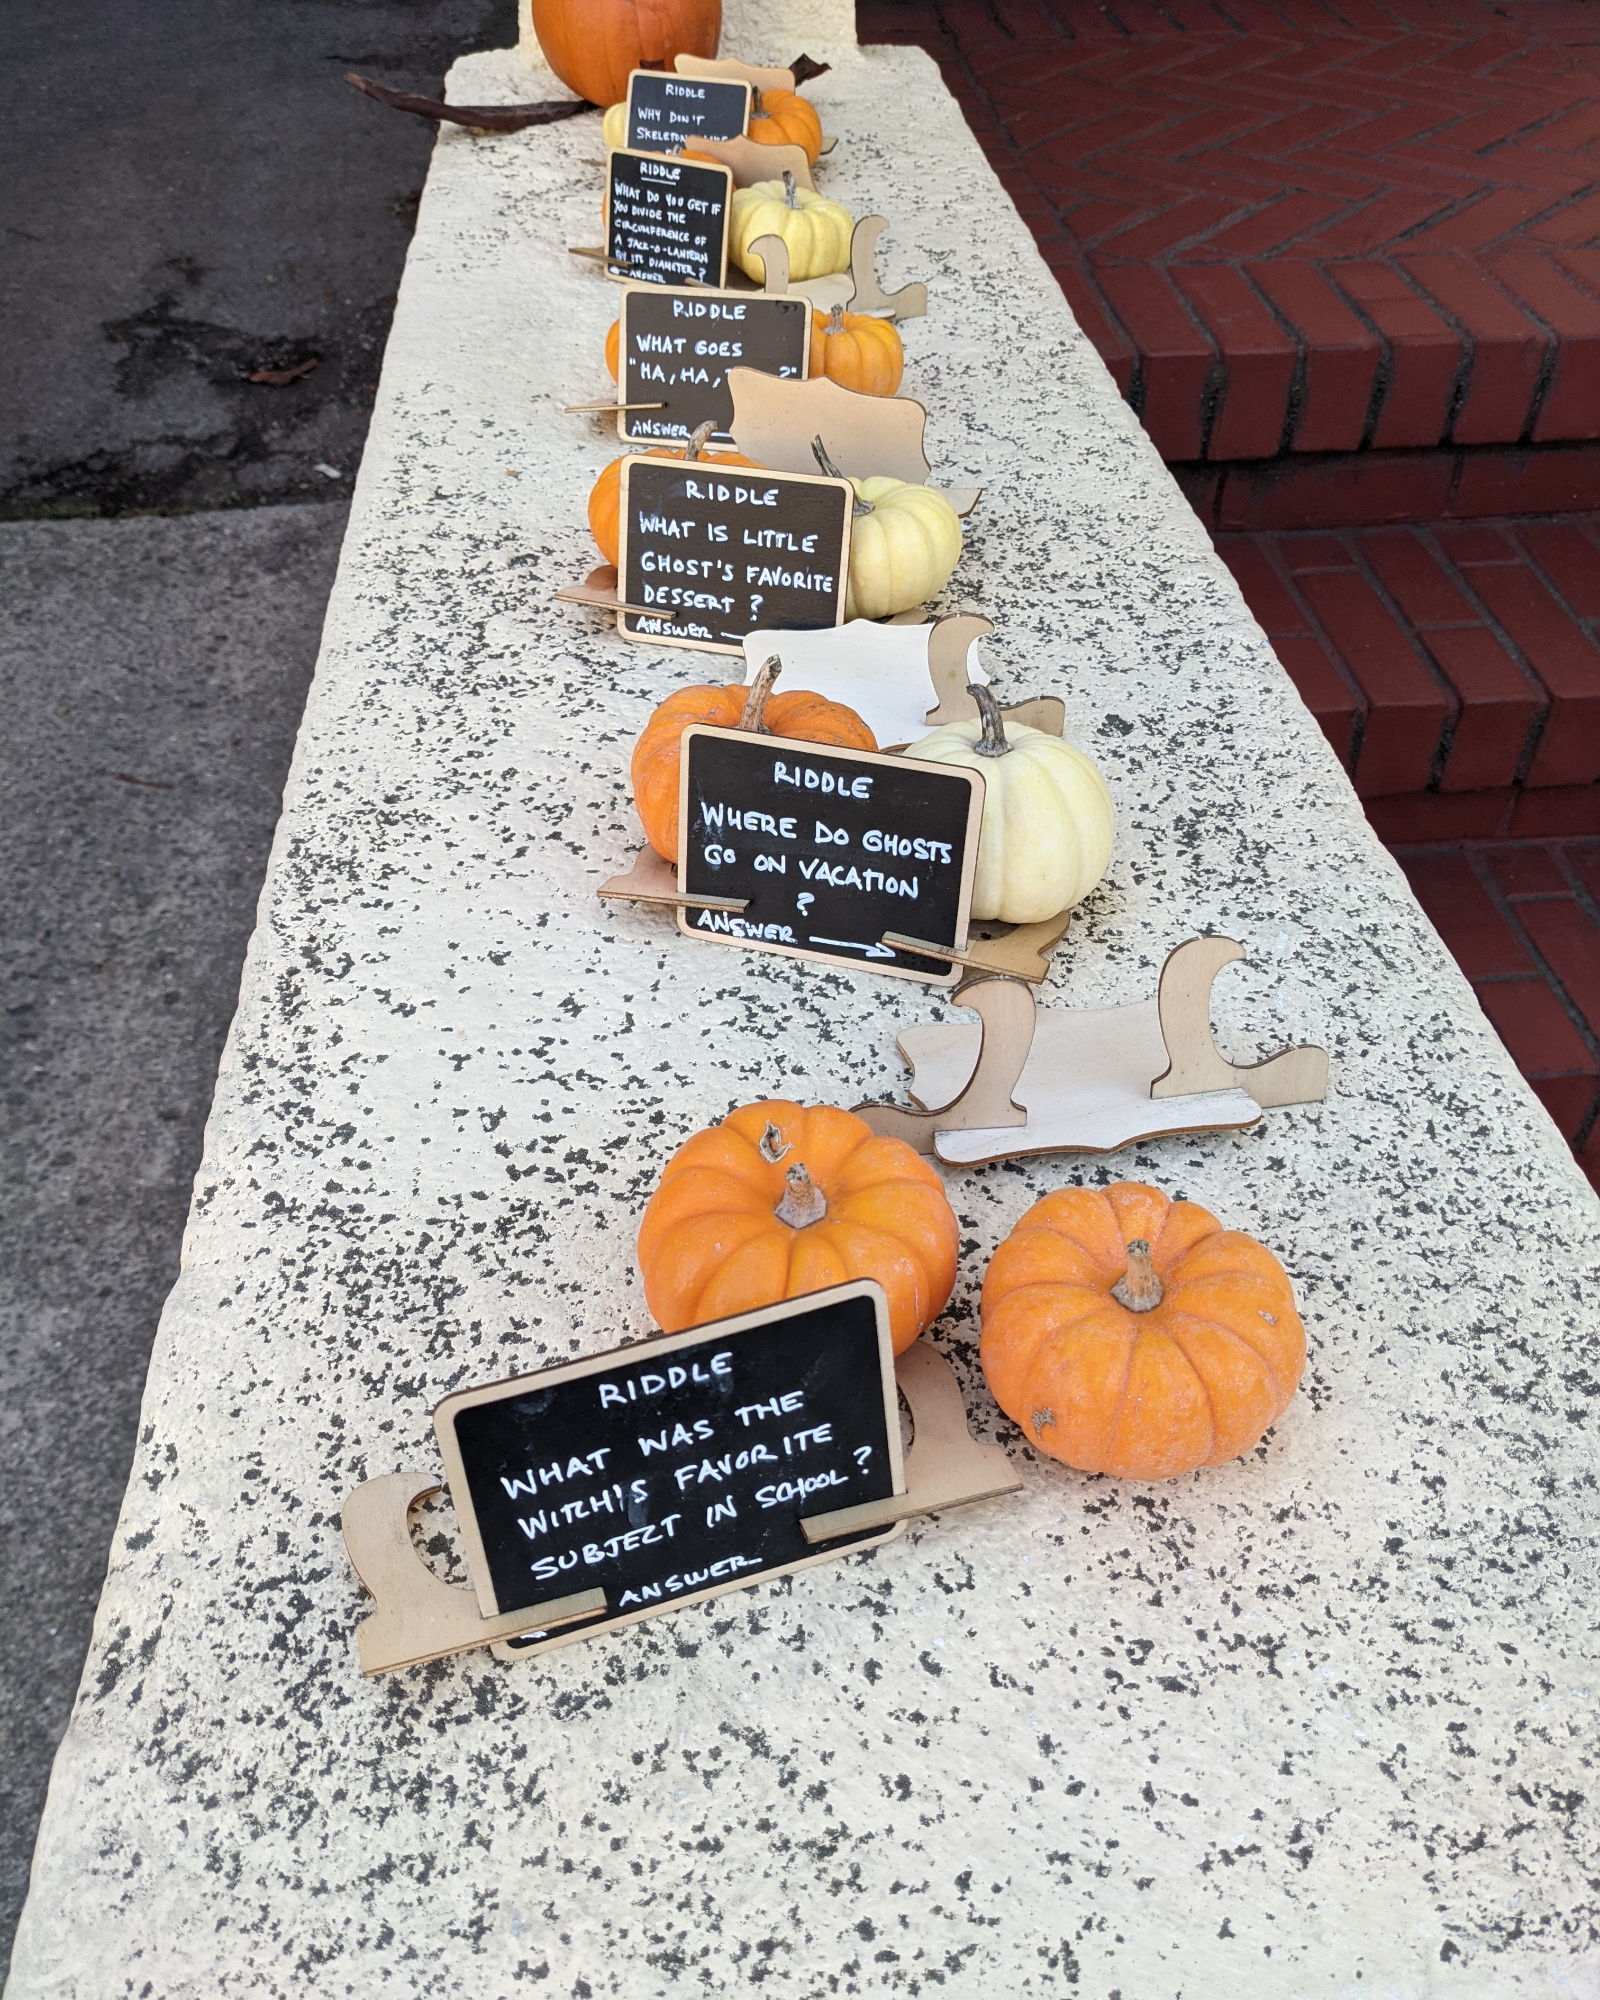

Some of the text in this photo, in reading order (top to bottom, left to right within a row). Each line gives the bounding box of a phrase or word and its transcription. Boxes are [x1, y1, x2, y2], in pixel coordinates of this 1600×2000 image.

[665, 83, 706, 99] RIDDLE
[637, 107, 705, 126] WHY DON'T
[636, 126, 688, 143] SKELETON
[640, 161, 681, 180] RIDDLE
[613, 199, 686, 224] YOU DIVIDE THE
[614, 182, 722, 215] WHAT DO YOU GET IF
[614, 219, 707, 246] CIRCUMFERENCE OF
[614, 233, 709, 264] A JACK-O-LANTERN
[629, 269, 667, 284] ANSWER
[631, 253, 644, 264] ITS
[648, 257, 700, 277] DIAMETER
[673, 299, 747, 320] RIDDLE
[636, 333, 743, 357] WHAT GOES
[631, 419, 692, 439] ANSWER
[685, 479, 779, 506] RIDDLE
[638, 511, 819, 553] WHAT IS LITTLE
[640, 551, 834, 593] GHOST'S FAVORITE
[643, 584, 764, 622] DESSERT ?
[636, 615, 713, 639] ANSWER
[774, 761, 874, 799] RIDDLE
[700, 801, 953, 864] WHERE DO GHOSTS
[704, 844, 919, 899] GO ON VACATION
[796, 891, 816, 917] ?
[696, 909, 797, 944] ANSWER
[600, 1351, 734, 1409] RIDDLE
[500, 1390, 805, 1500] WHAT WAS THE
[517, 1422, 834, 1540] WITCH'S FAVORITE
[530, 1445, 874, 1581] SUBJECT IN SCHOOL ?
[618, 1556, 764, 1607] ANSWER
